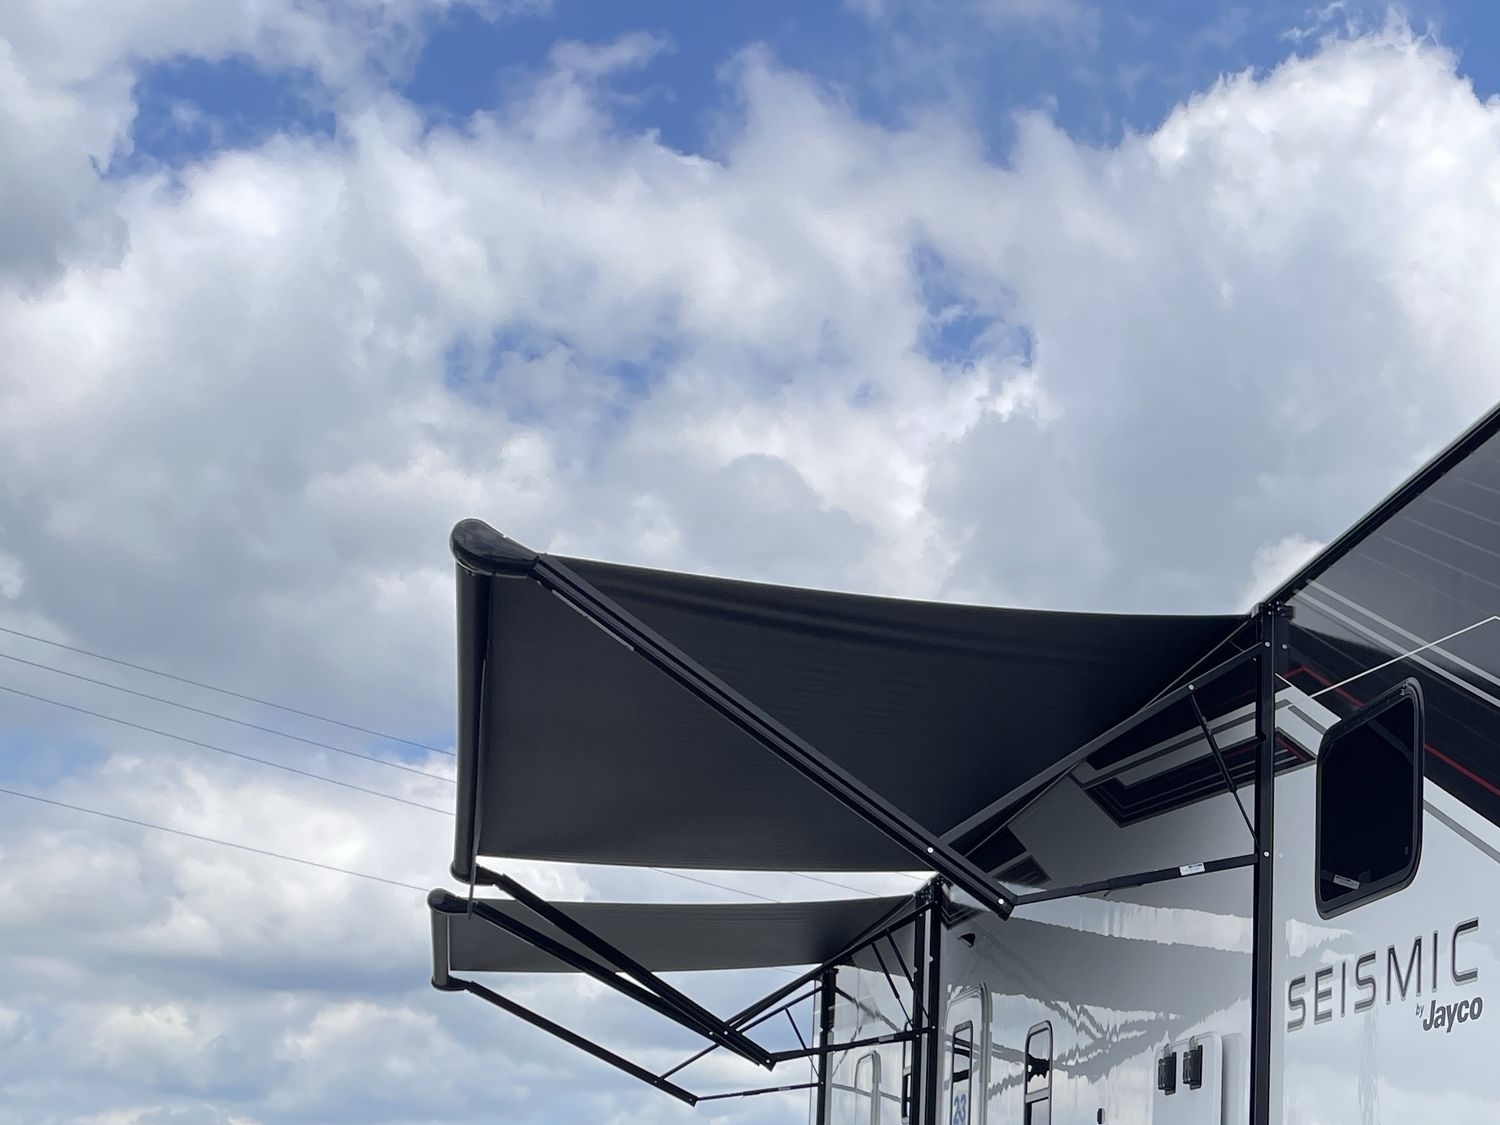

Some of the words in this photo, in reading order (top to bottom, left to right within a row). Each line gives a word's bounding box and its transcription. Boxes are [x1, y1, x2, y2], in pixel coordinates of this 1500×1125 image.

[1287, 917, 1479, 1032] SEISMIC
[1415, 1004, 1425, 1018] by
[1423, 996, 1483, 1033] Jayco
